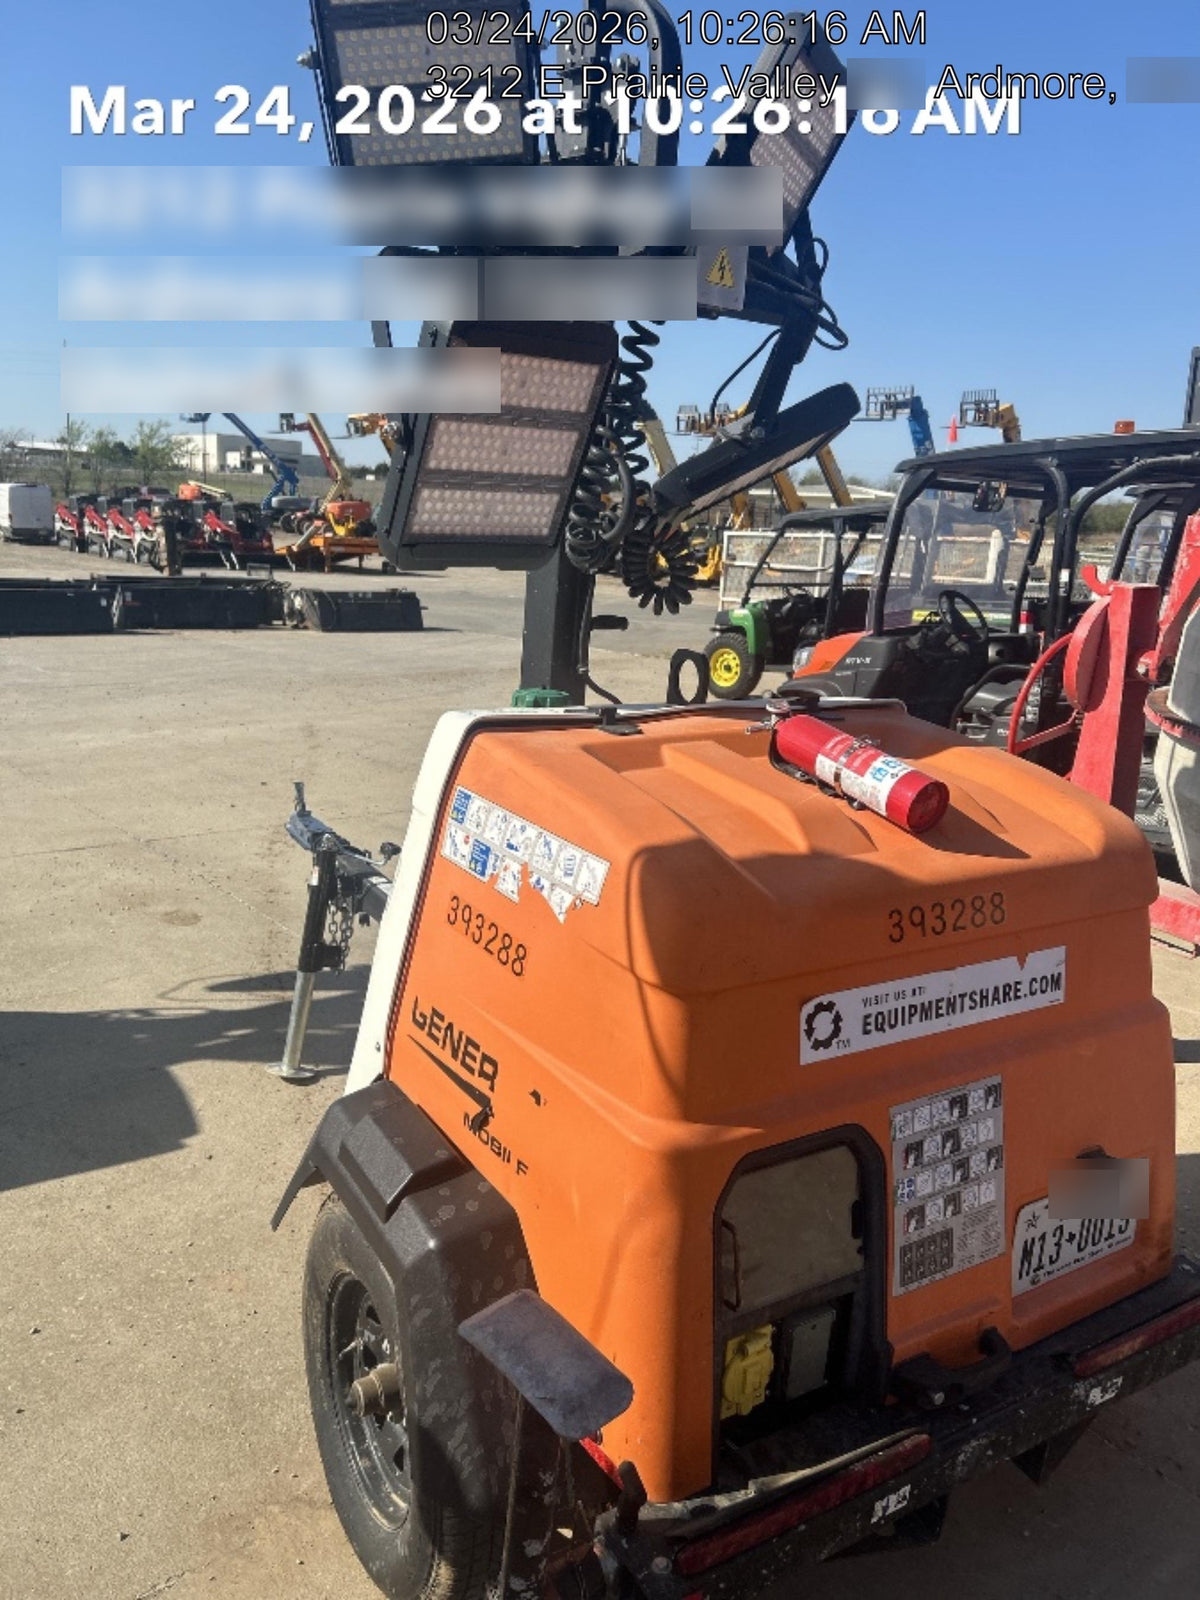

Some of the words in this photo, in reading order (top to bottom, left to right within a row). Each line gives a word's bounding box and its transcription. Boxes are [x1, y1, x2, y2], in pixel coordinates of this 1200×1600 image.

[447, 895, 527, 977] 393288
[888, 891, 1006, 943] 393288
[862, 993, 890, 1008] VISIT
[894, 989, 908, 1001] US
[862, 972, 1062, 1036] EQUIPMENTSHARE.COM
